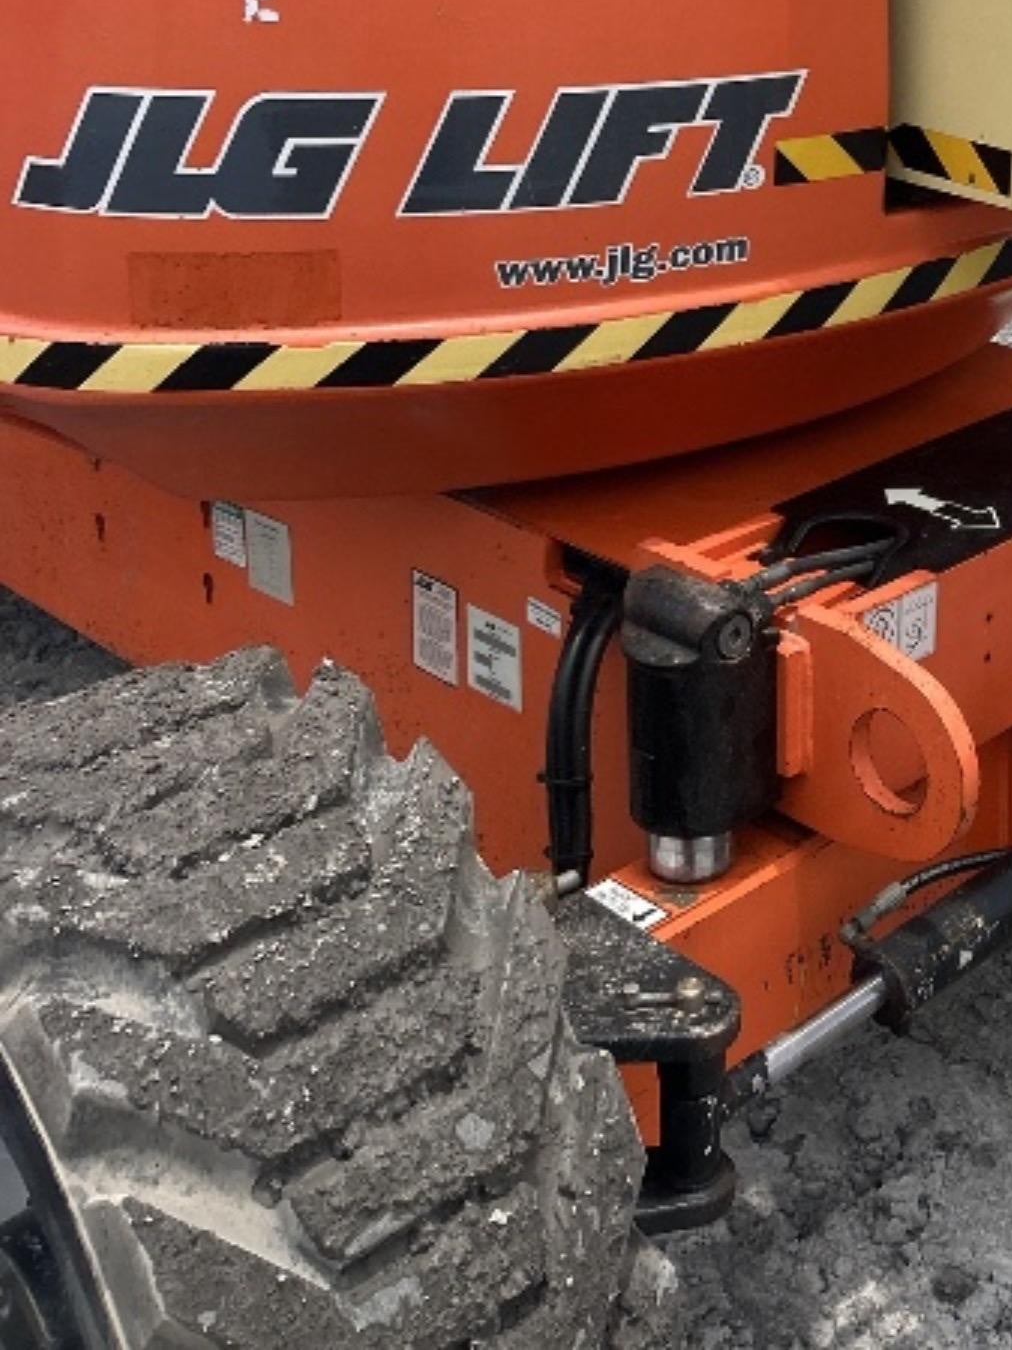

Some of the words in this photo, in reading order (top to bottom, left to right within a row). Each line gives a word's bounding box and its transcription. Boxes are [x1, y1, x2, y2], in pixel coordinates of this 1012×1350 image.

[11, 85, 388, 220] JLG
[395, 68, 809, 218] LIFT
[494, 236, 750, 288] www.jlg.com
